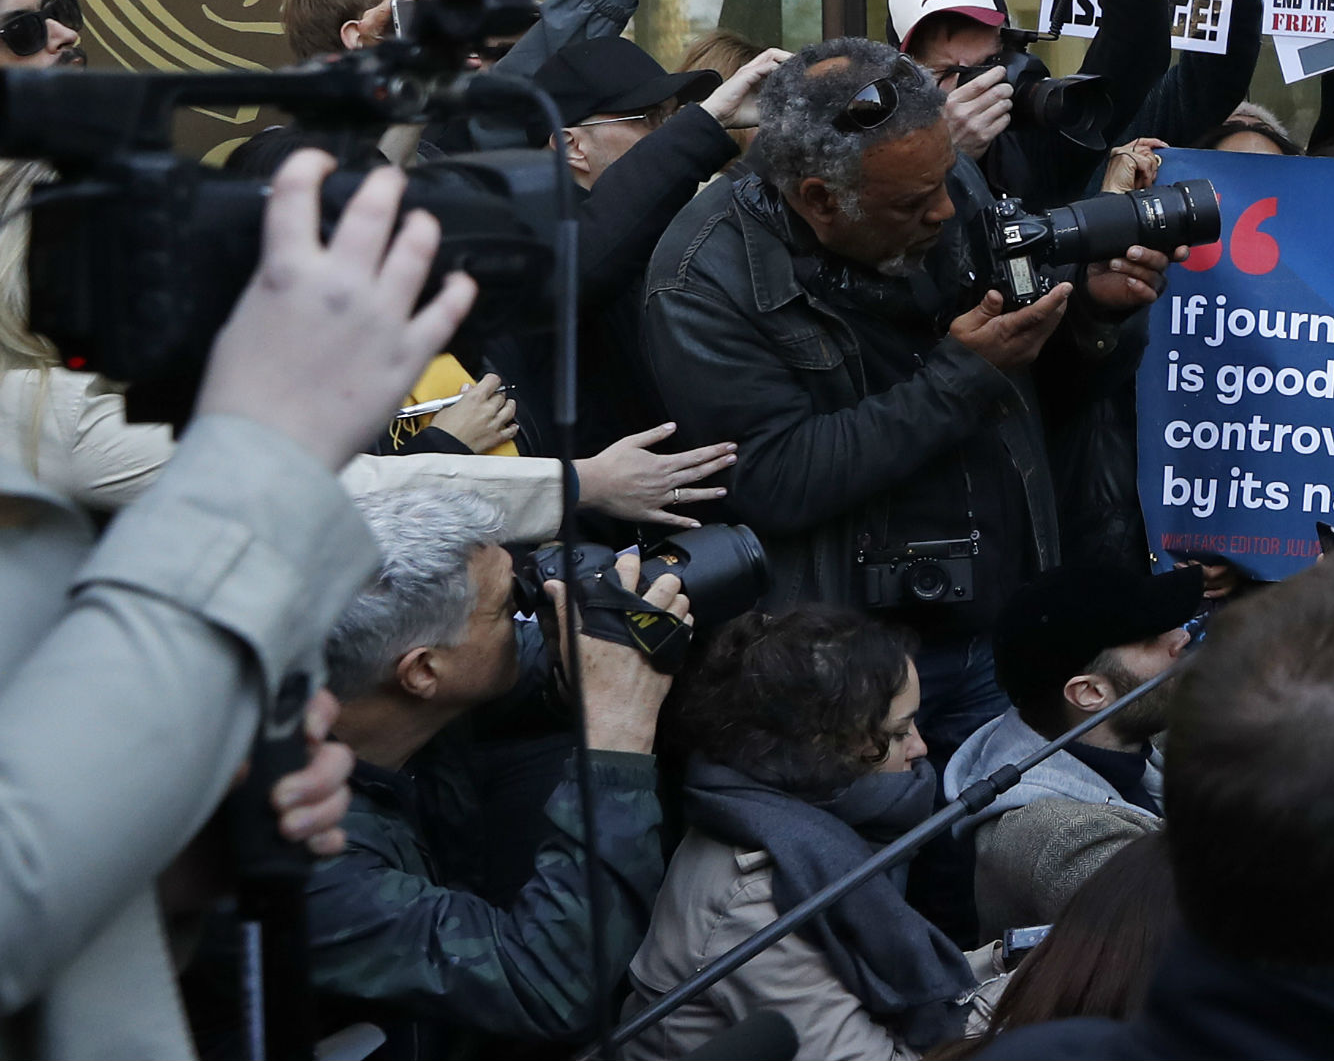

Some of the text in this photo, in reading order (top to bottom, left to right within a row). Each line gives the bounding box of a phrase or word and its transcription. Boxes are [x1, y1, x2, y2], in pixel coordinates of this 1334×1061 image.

[1272, 13, 1327, 33] FREE
[1170, 294, 1208, 336] If
[1167, 350, 1205, 392] is
[1162, 465, 1218, 518] by
[1228, 466, 1289, 510] its
[1230, 535, 1280, 555] EDITOR
